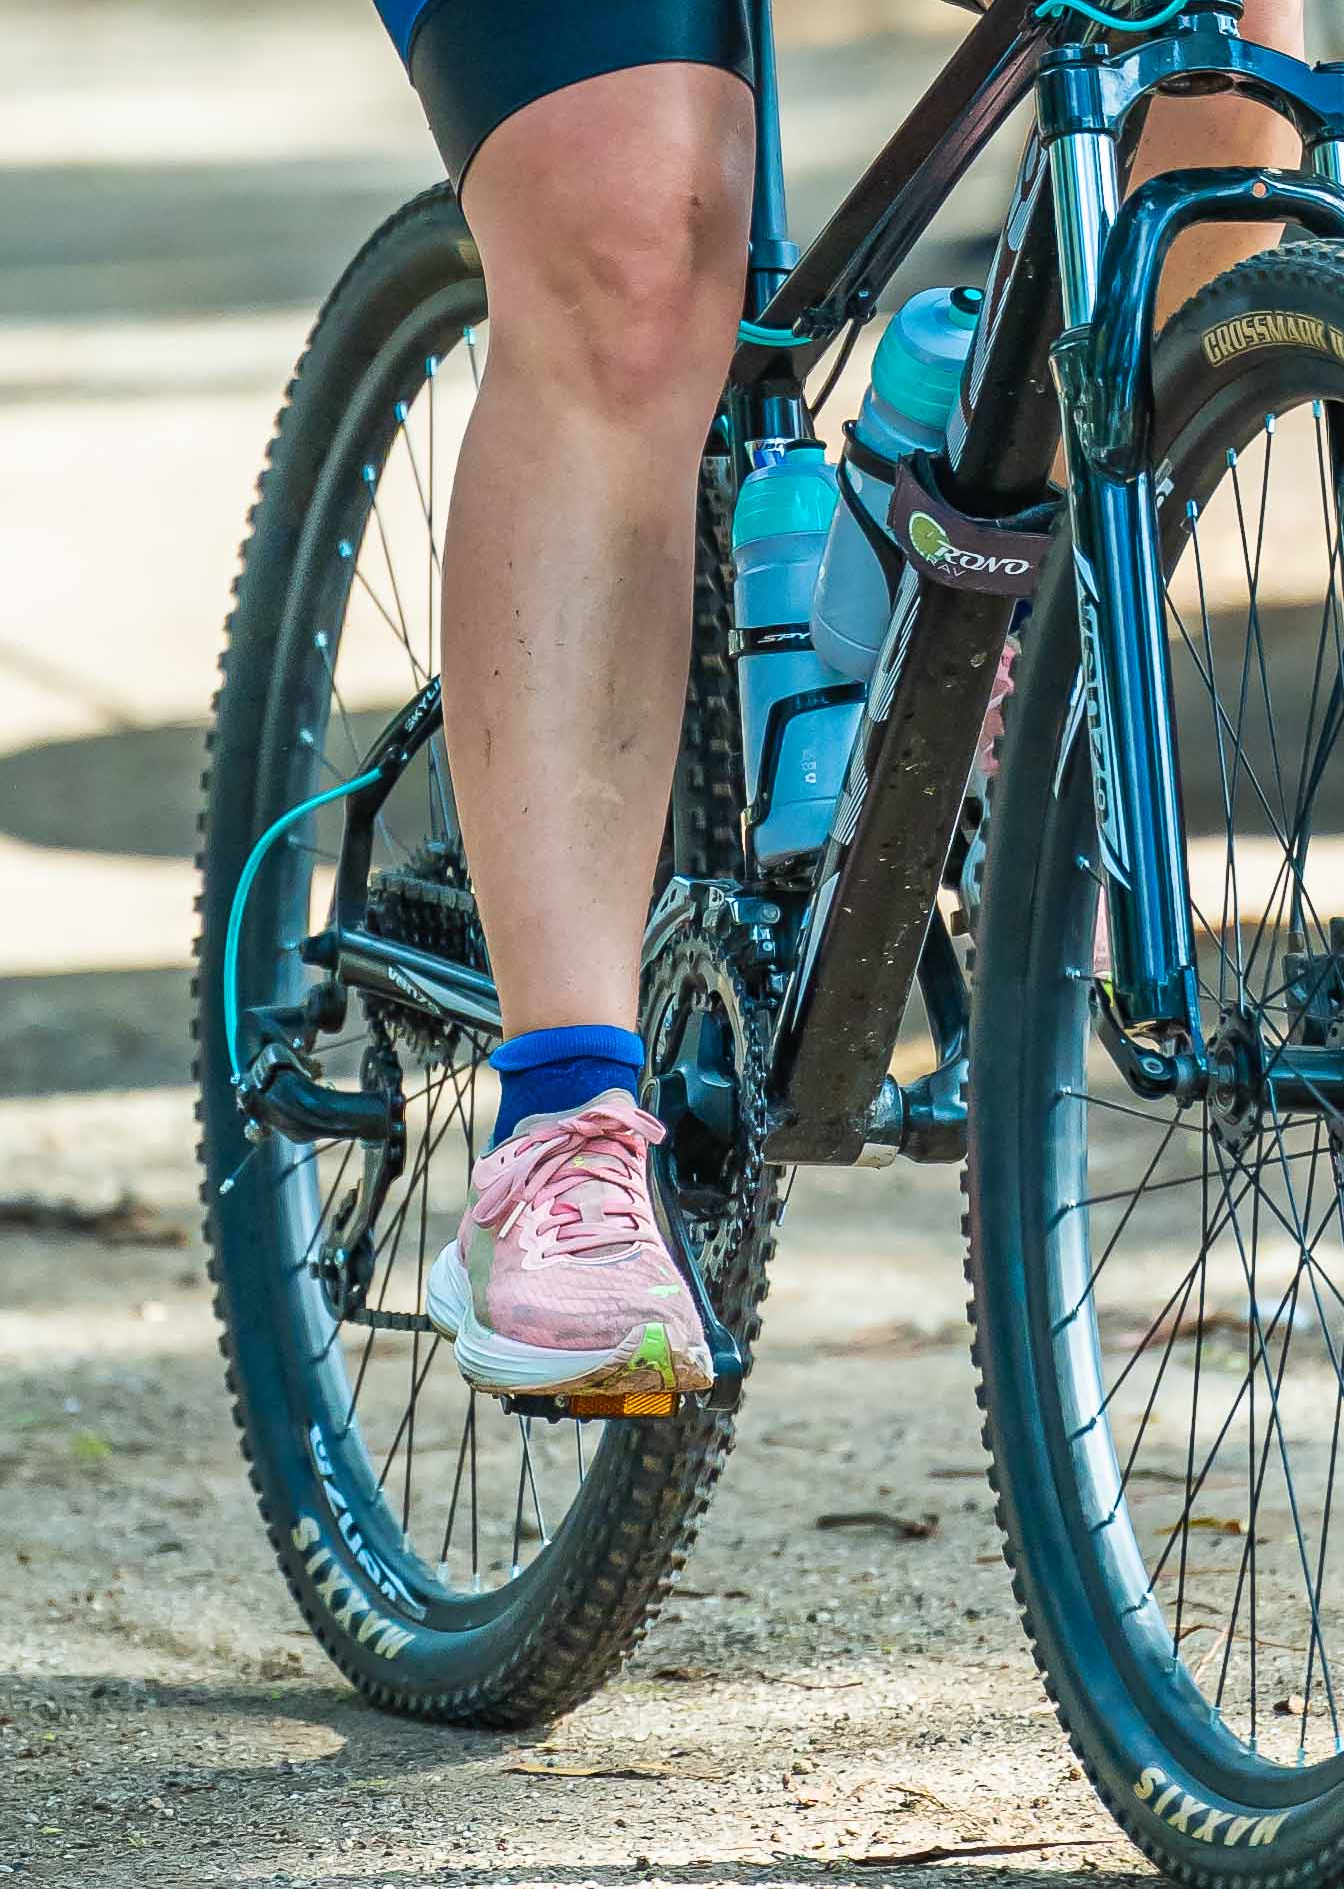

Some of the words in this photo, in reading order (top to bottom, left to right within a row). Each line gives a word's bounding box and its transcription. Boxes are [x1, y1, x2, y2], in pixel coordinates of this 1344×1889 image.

[1204, 313, 1328, 366] CROSSMARK
[291, 1515, 416, 1659] MAXXIS
[1133, 1766, 1292, 1847] MAXXIS
